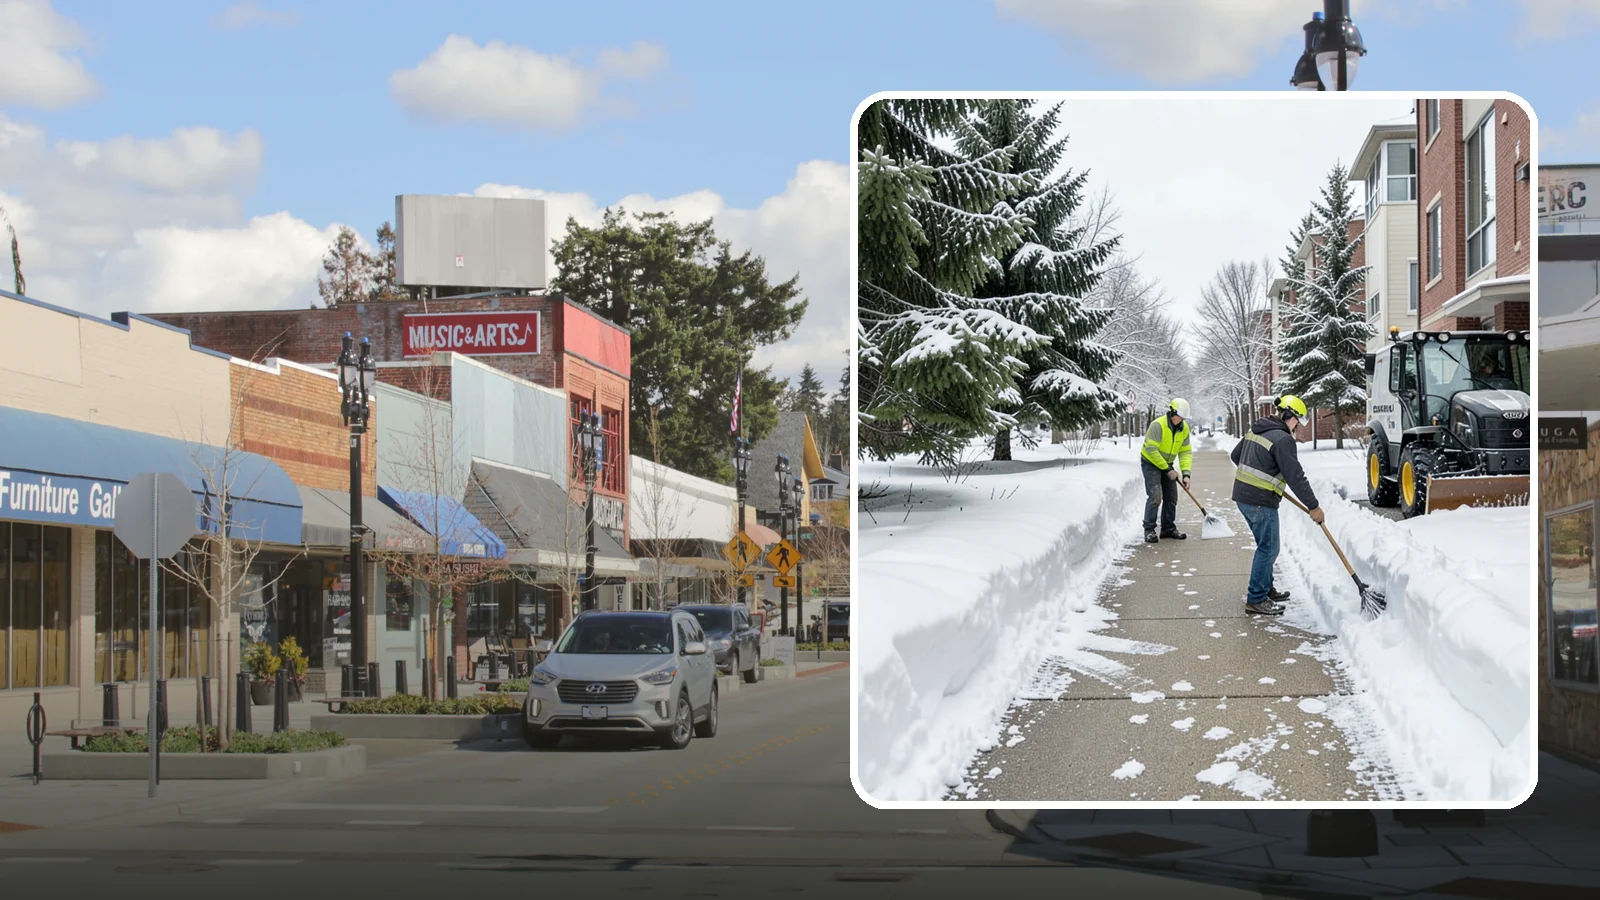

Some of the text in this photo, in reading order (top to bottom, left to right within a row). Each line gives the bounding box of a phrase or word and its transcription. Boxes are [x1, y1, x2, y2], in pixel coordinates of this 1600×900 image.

[1540, 427, 1578, 436] UGA
[1551, 436, 1579, 444] Framing
[0, 472, 79, 515] Furniture
[453, 563, 478, 574] SUSHI
